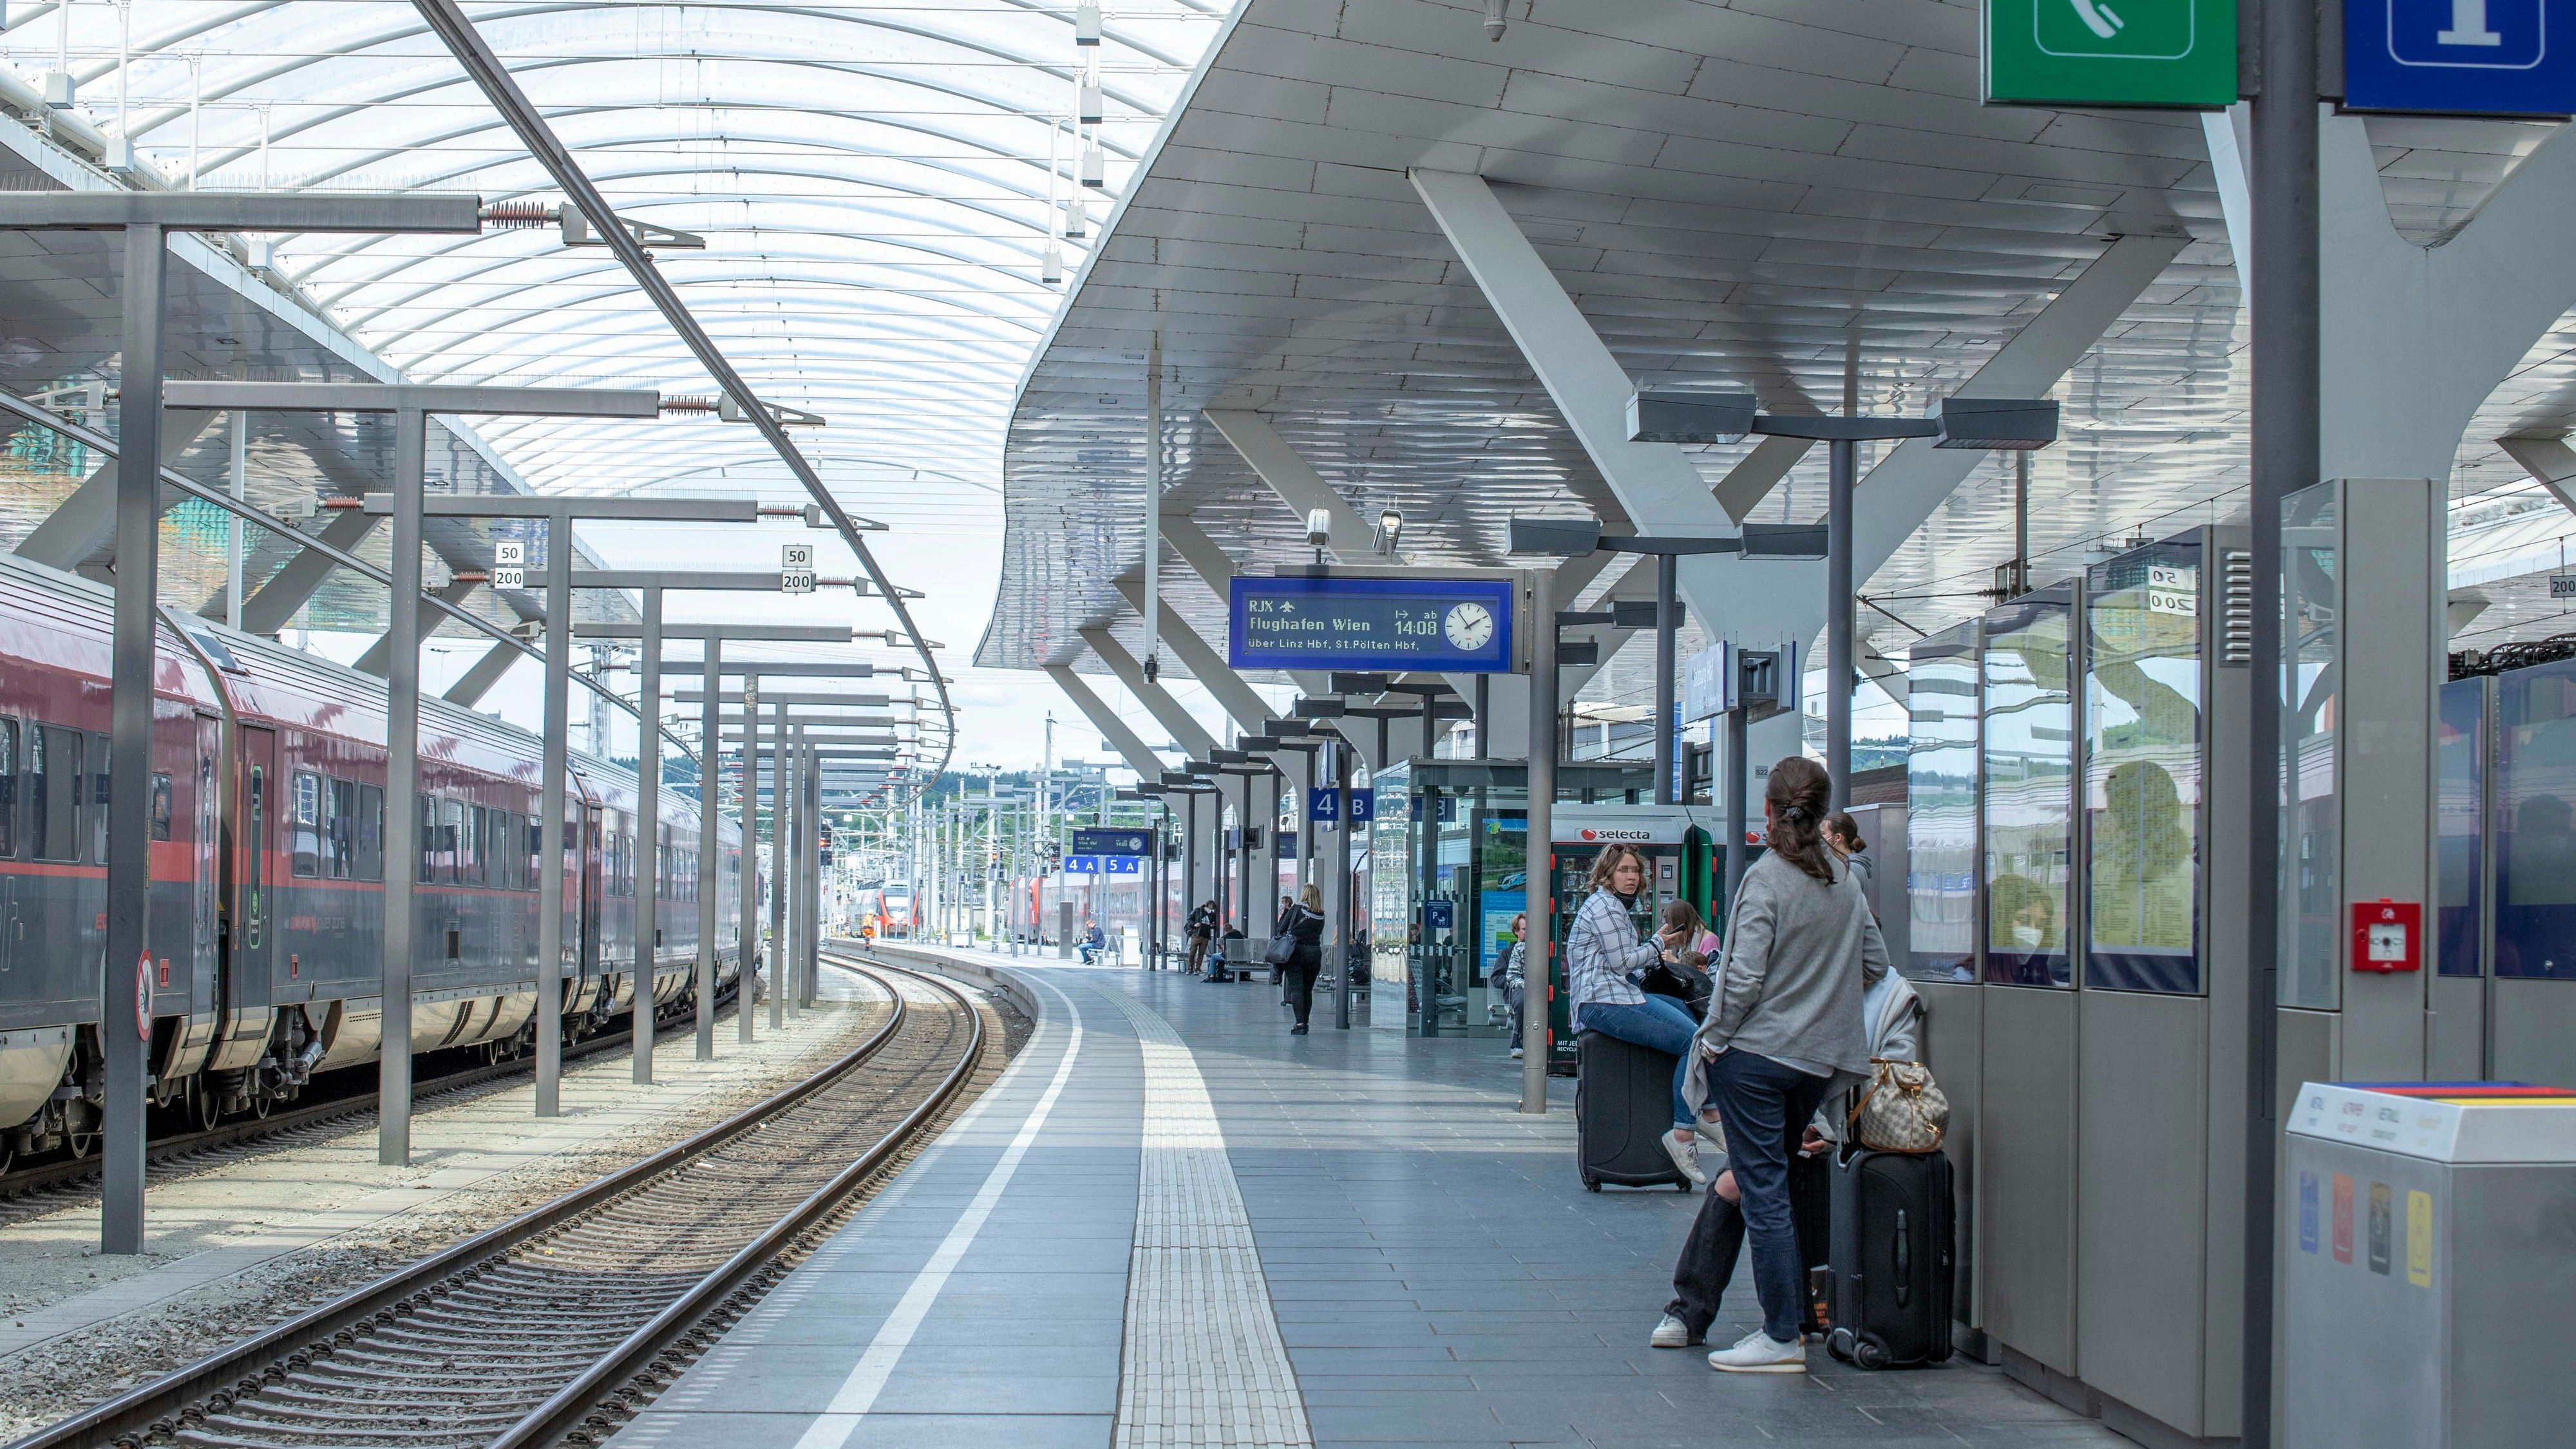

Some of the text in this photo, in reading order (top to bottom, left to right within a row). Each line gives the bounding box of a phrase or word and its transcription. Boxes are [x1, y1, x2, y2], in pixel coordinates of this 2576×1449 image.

[502, 547, 518, 558] 50
[789, 551, 806, 562] 50
[497, 573, 522, 584] 200
[784, 576, 810, 587] 200
[2553, 581, 2575, 592] 200
[1249, 600, 1273, 612] RJX
[1424, 611, 1437, 619] ab
[1250, 618, 1370, 631] Flughafen Wien
[1394, 621, 1437, 635] 14:08
[1249, 638, 1419, 650] über Linz Hbf, St.Pölten Hbf,
[1317, 793, 1364, 815] 4 B
[1598, 830, 1650, 839] selecta
[1069, 859, 1094, 871] 4 A
[1110, 860, 1134, 871] 5 A
[1432, 911, 1438, 920] P
